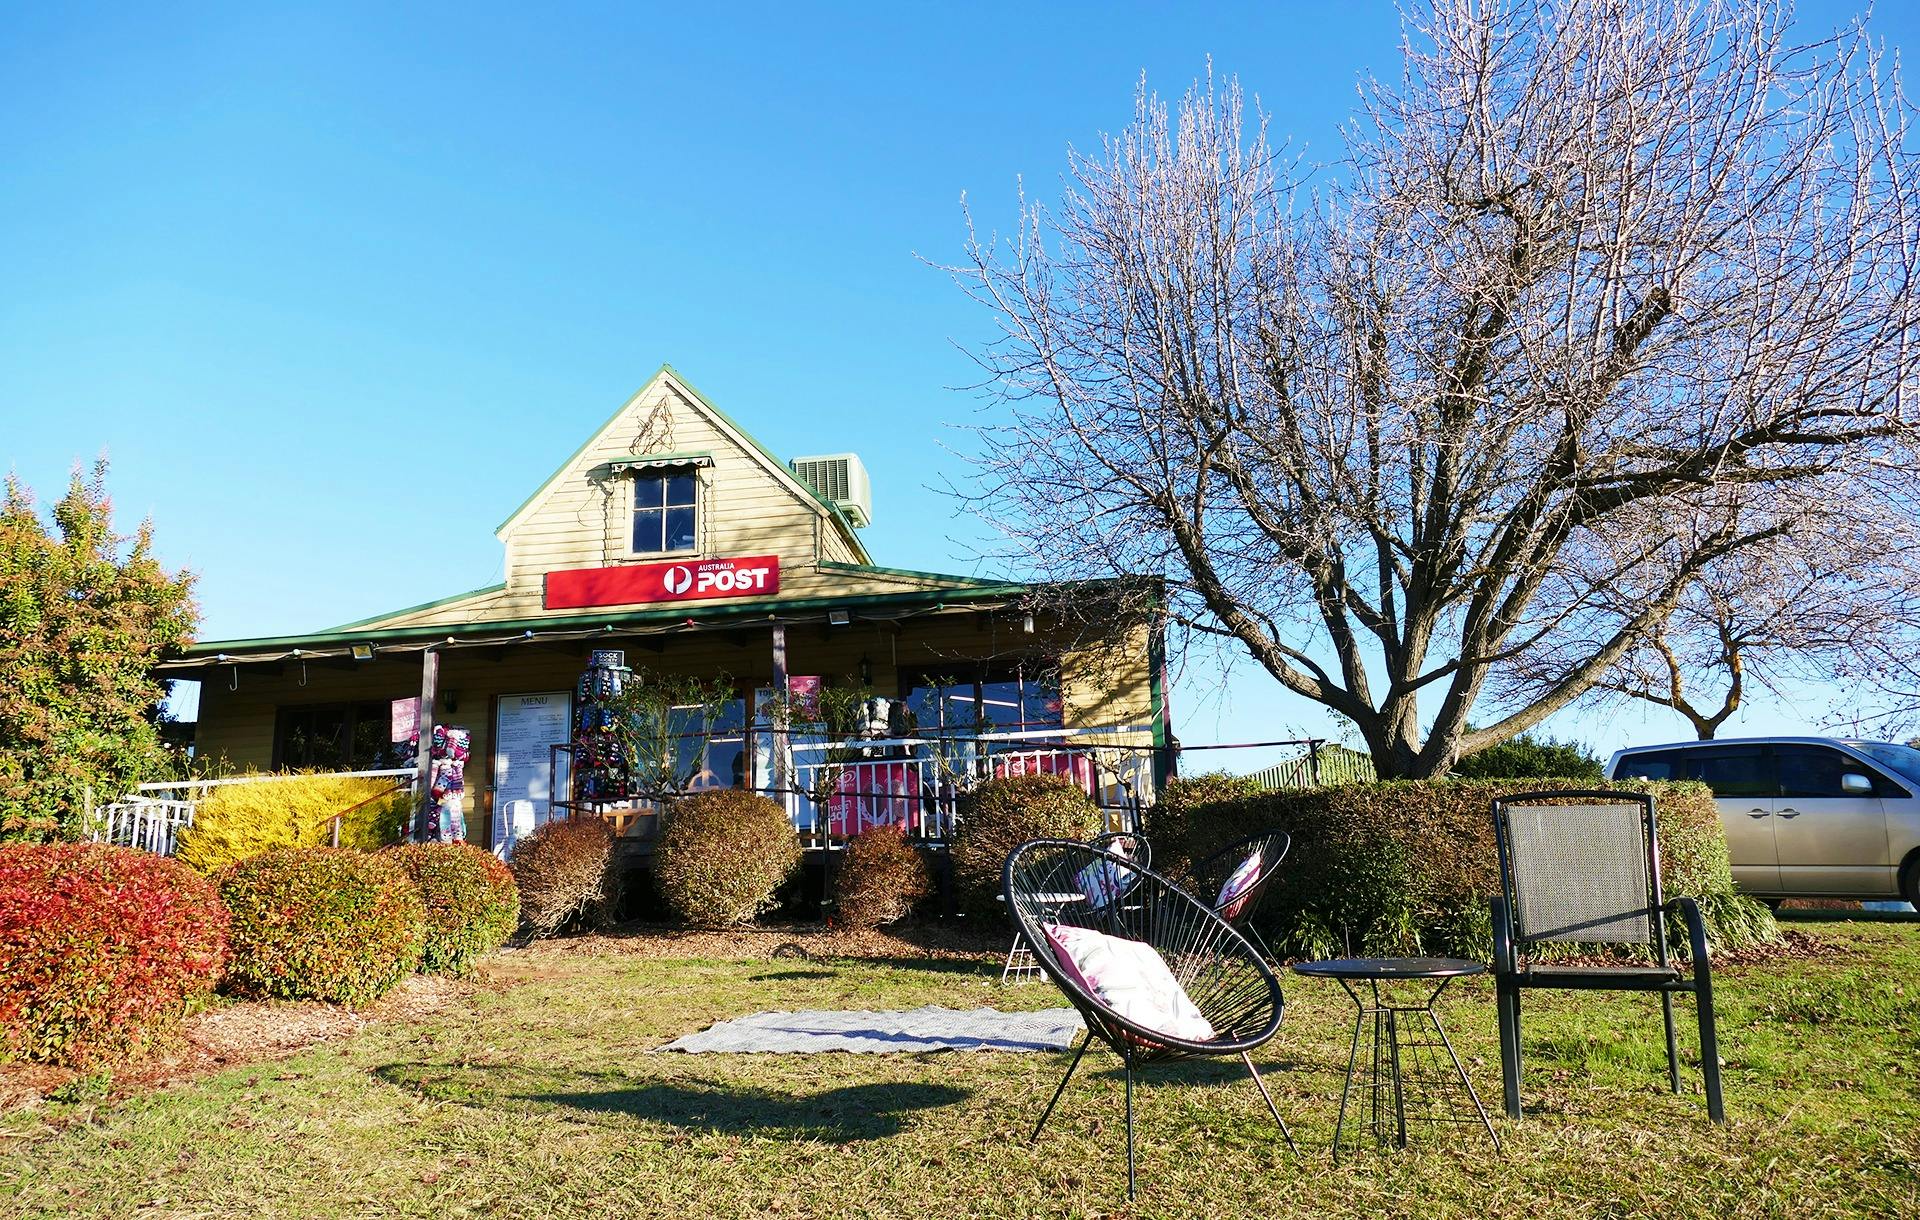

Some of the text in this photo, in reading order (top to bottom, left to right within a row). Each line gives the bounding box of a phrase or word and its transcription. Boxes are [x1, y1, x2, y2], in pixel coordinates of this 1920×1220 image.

[698, 562, 735, 571] AUSTRALIA
[697, 568, 769, 592] POST
[521, 696, 548, 706] MENU
[830, 803, 849, 811] TASE
